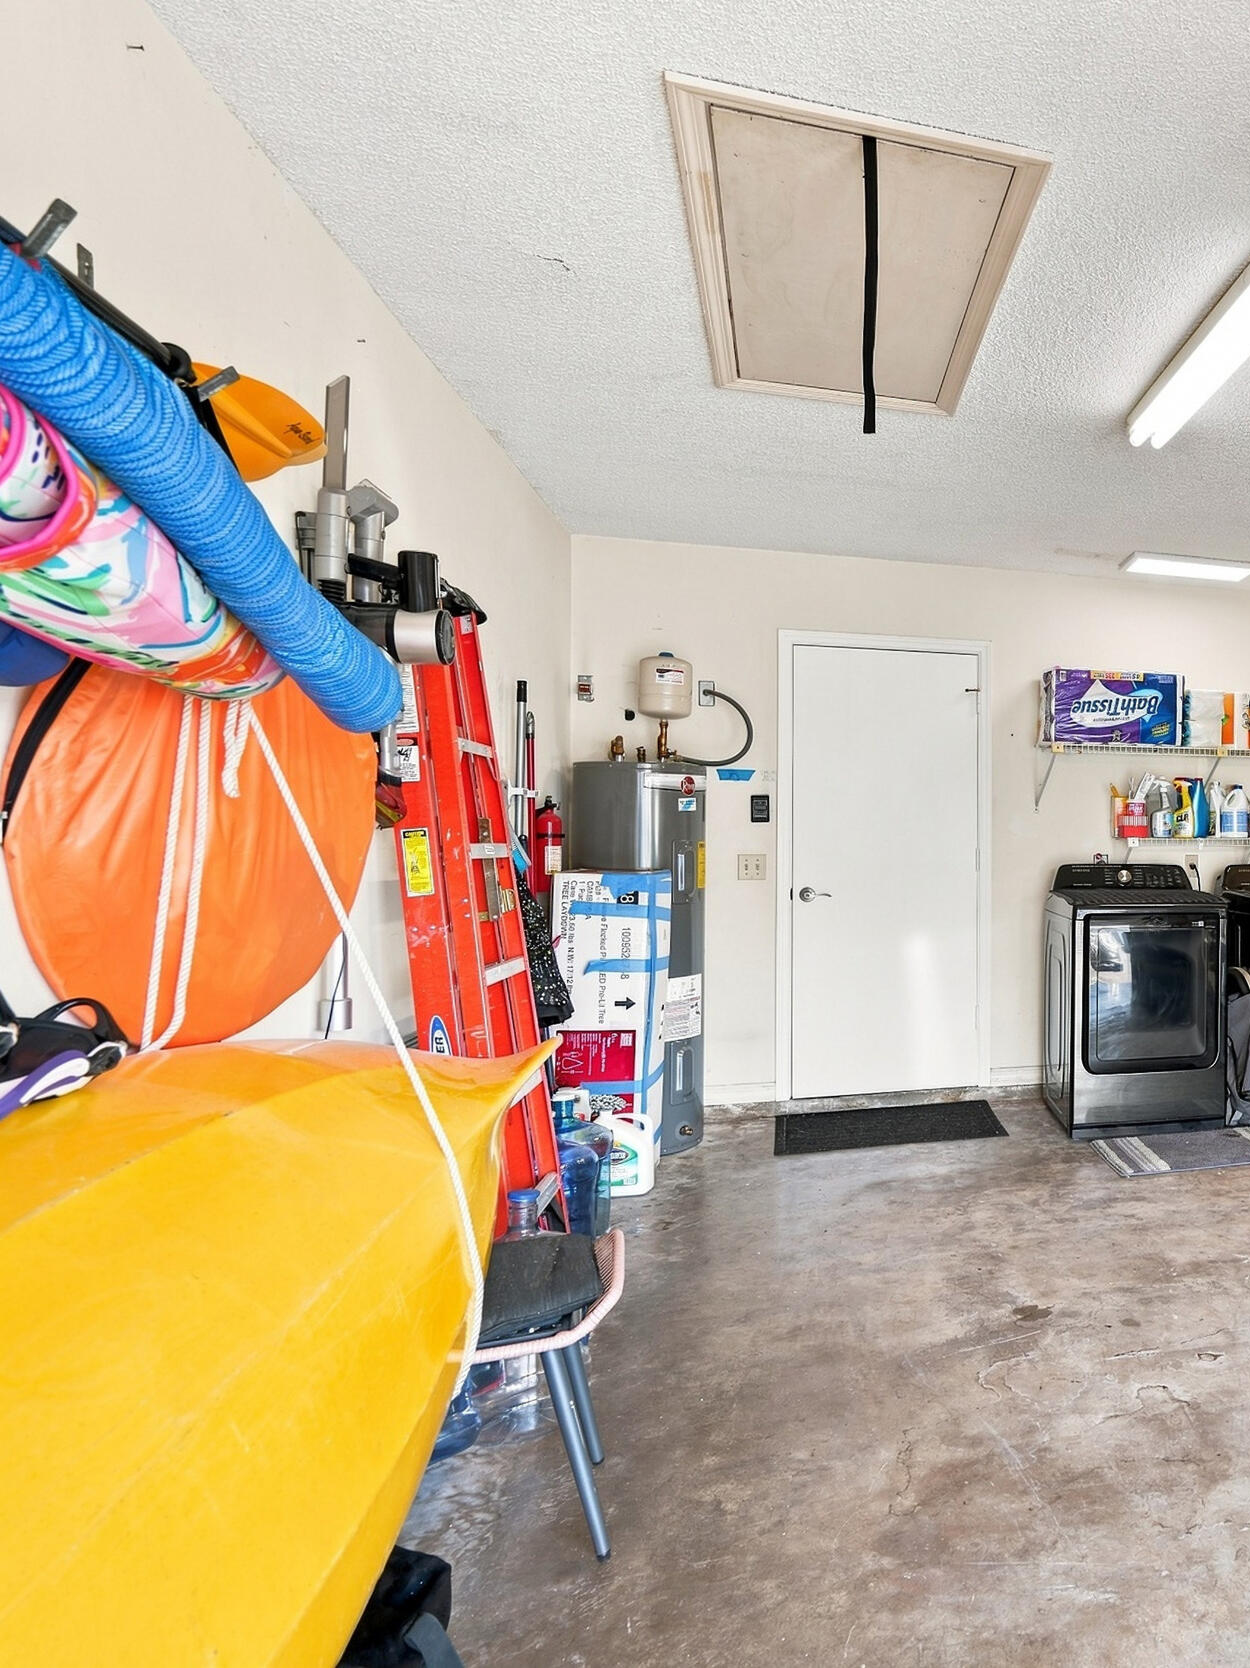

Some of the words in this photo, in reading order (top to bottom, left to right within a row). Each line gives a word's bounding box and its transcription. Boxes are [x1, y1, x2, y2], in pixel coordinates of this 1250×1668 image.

[561, 880, 569, 900] TREE
[620, 927, 631, 980] 1009528
[435, 1036, 445, 1054] ER
